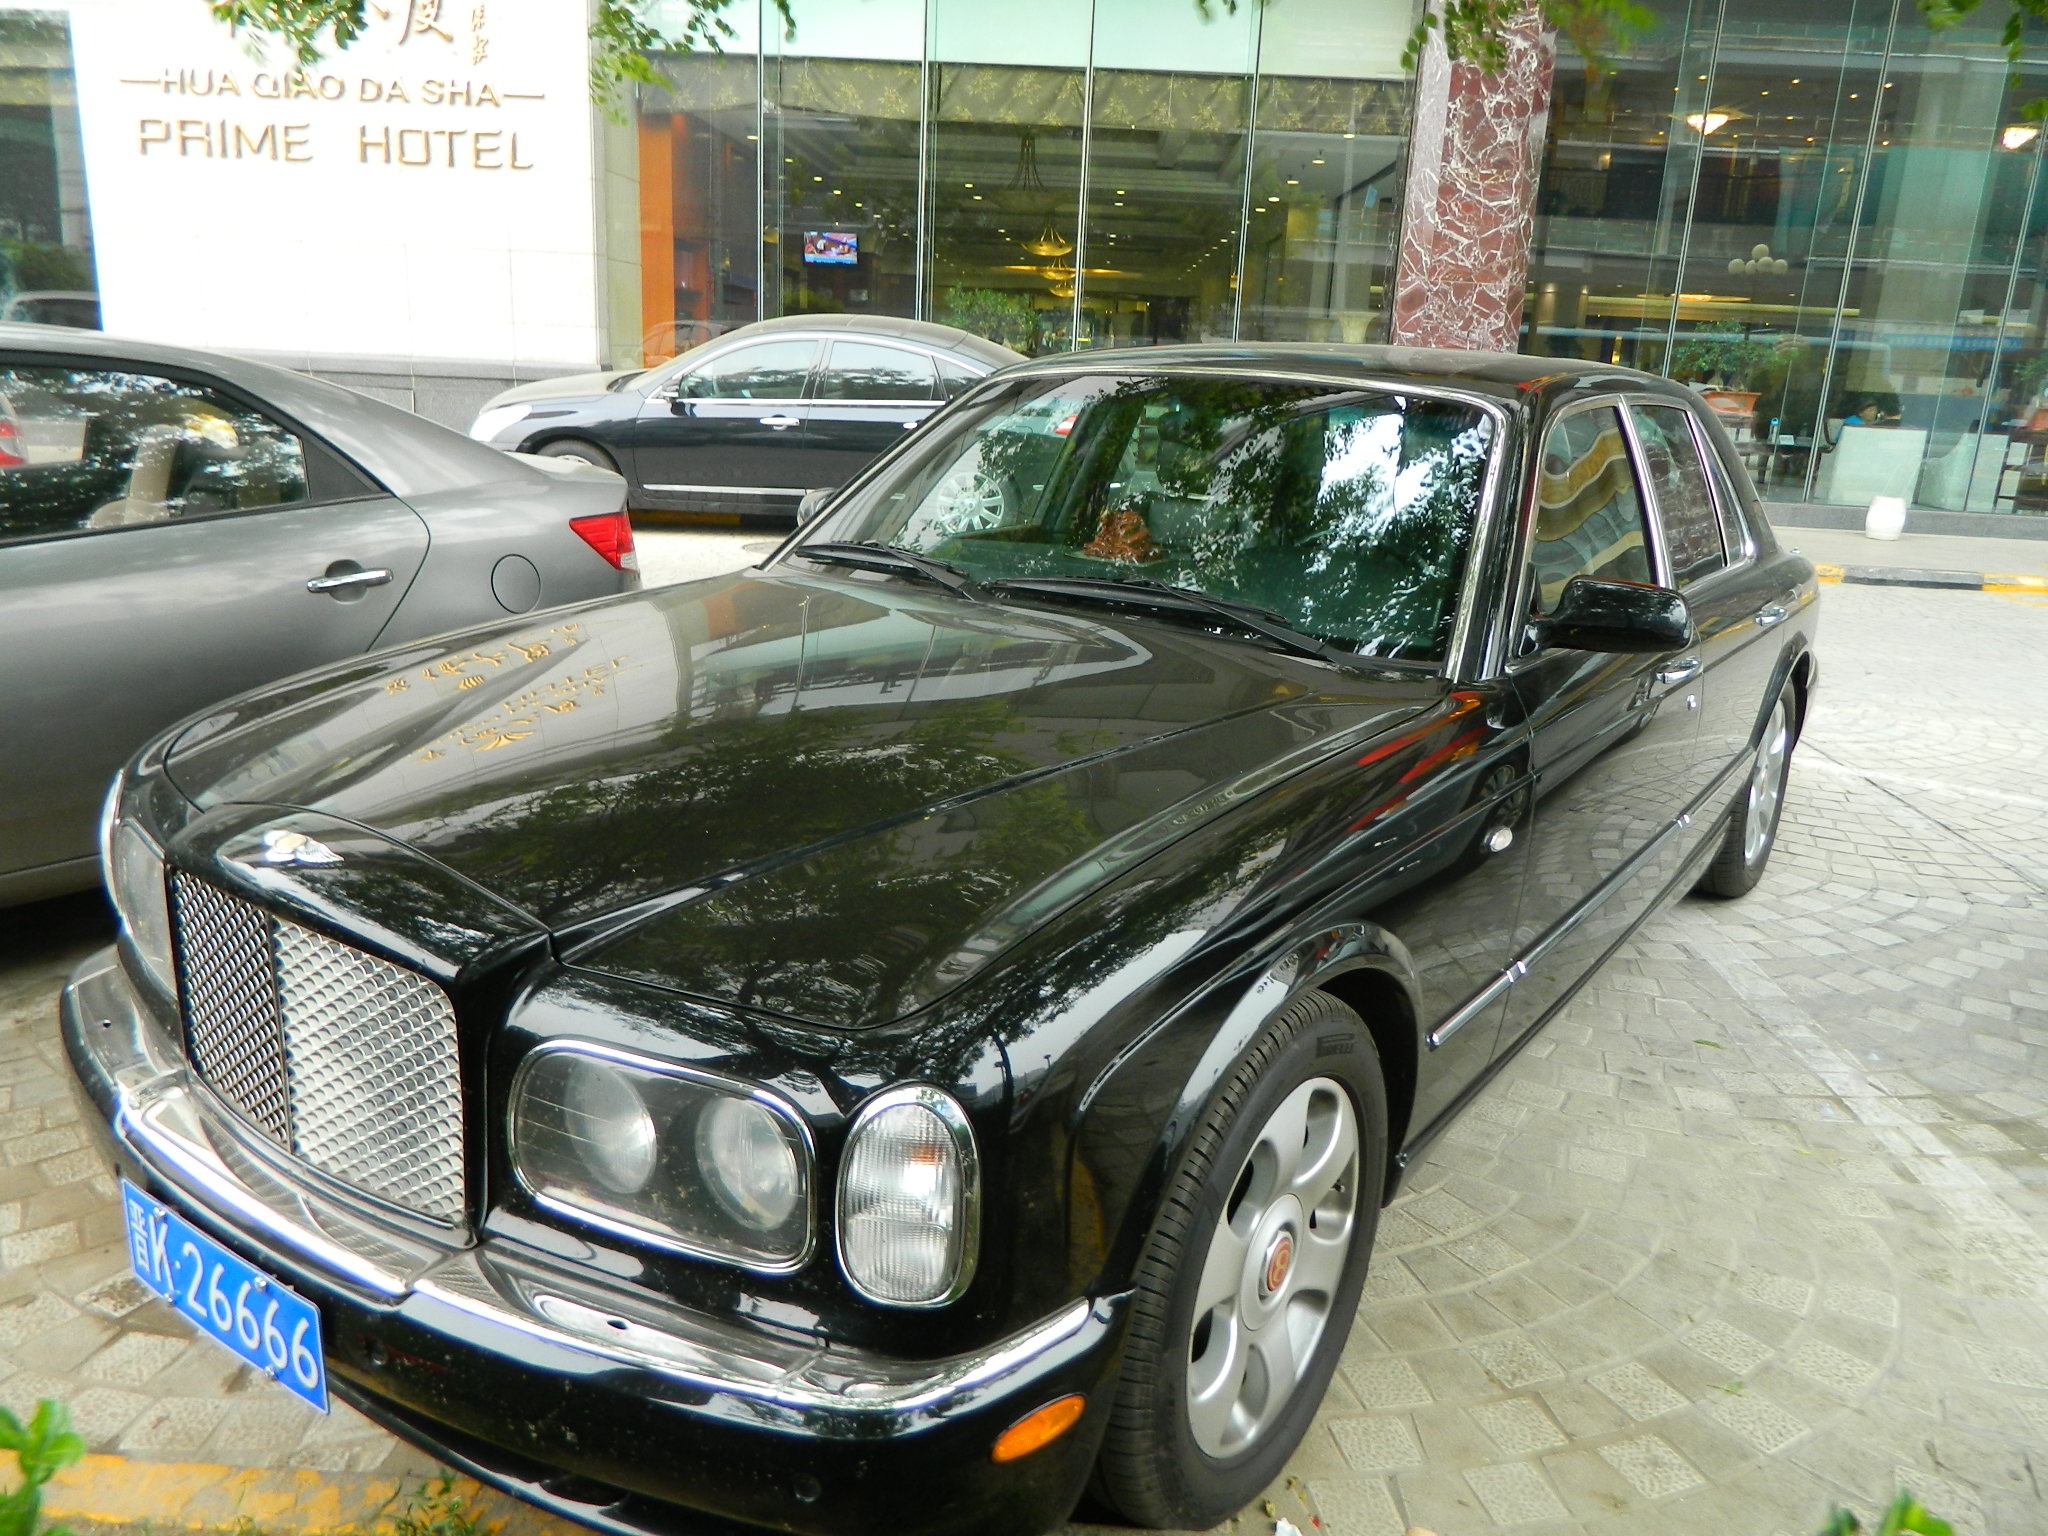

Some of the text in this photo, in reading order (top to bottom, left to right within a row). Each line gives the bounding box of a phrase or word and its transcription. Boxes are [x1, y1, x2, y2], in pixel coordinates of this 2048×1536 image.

[163, 68, 500, 107] HUA QIAO DA SHA
[139, 118, 534, 169] PRIME HOTEL
